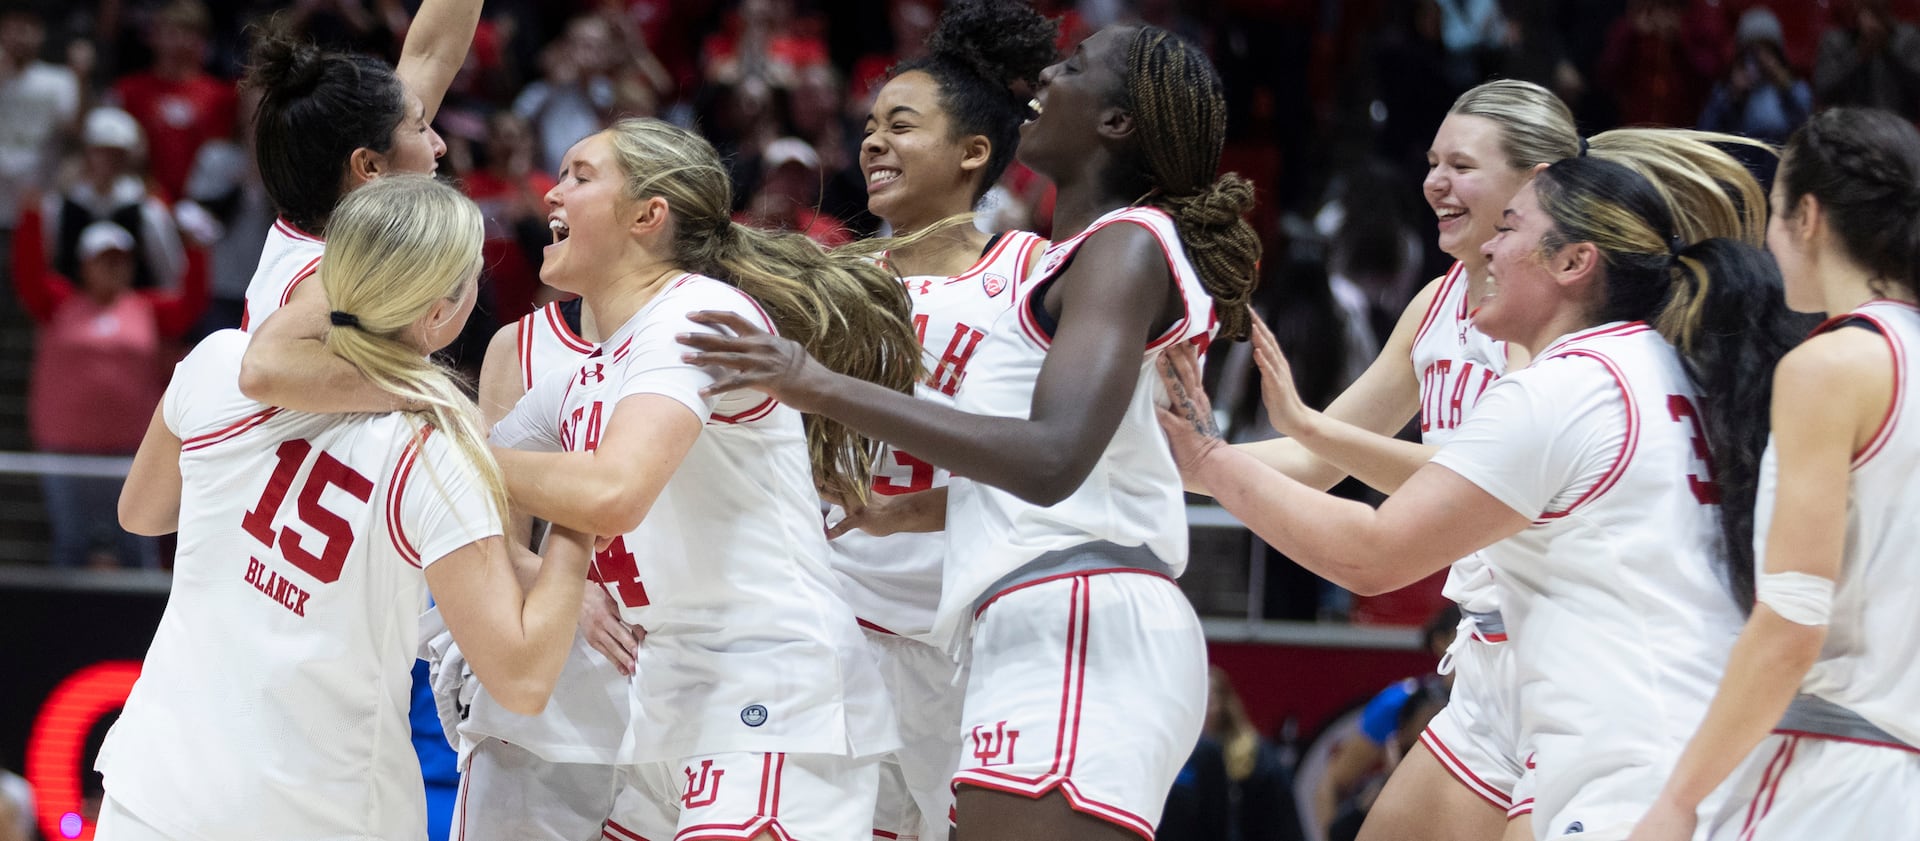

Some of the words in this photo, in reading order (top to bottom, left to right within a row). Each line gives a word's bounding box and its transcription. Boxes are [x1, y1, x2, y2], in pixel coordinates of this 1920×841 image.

[1421, 360, 1500, 432] UTA
[241, 438, 374, 584] 15
[244, 556, 310, 617] BLANCK
